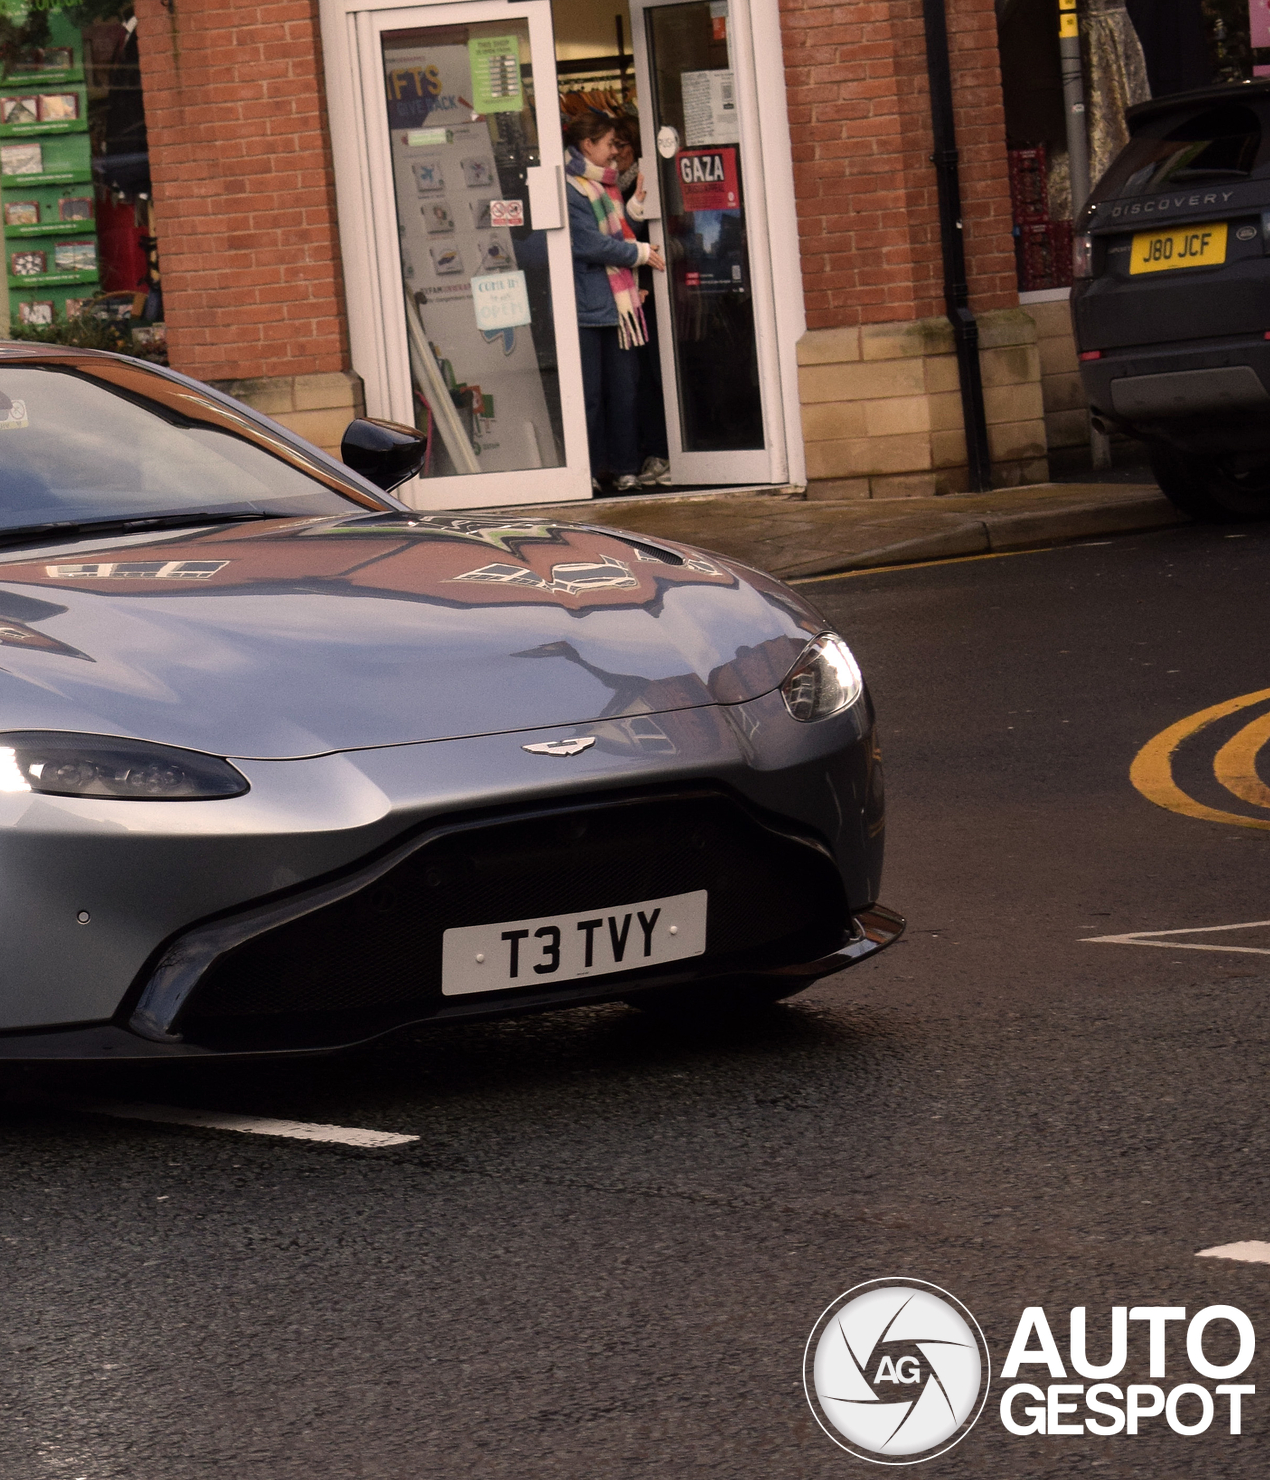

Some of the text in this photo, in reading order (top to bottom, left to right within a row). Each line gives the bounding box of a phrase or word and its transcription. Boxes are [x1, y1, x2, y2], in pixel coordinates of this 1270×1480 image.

[680, 156, 725, 183] GAZA
[1112, 191, 1234, 217] DISCOVERY
[1143, 233, 1212, 263] J80 JCF
[501, 907, 662, 978] T3 TVY
